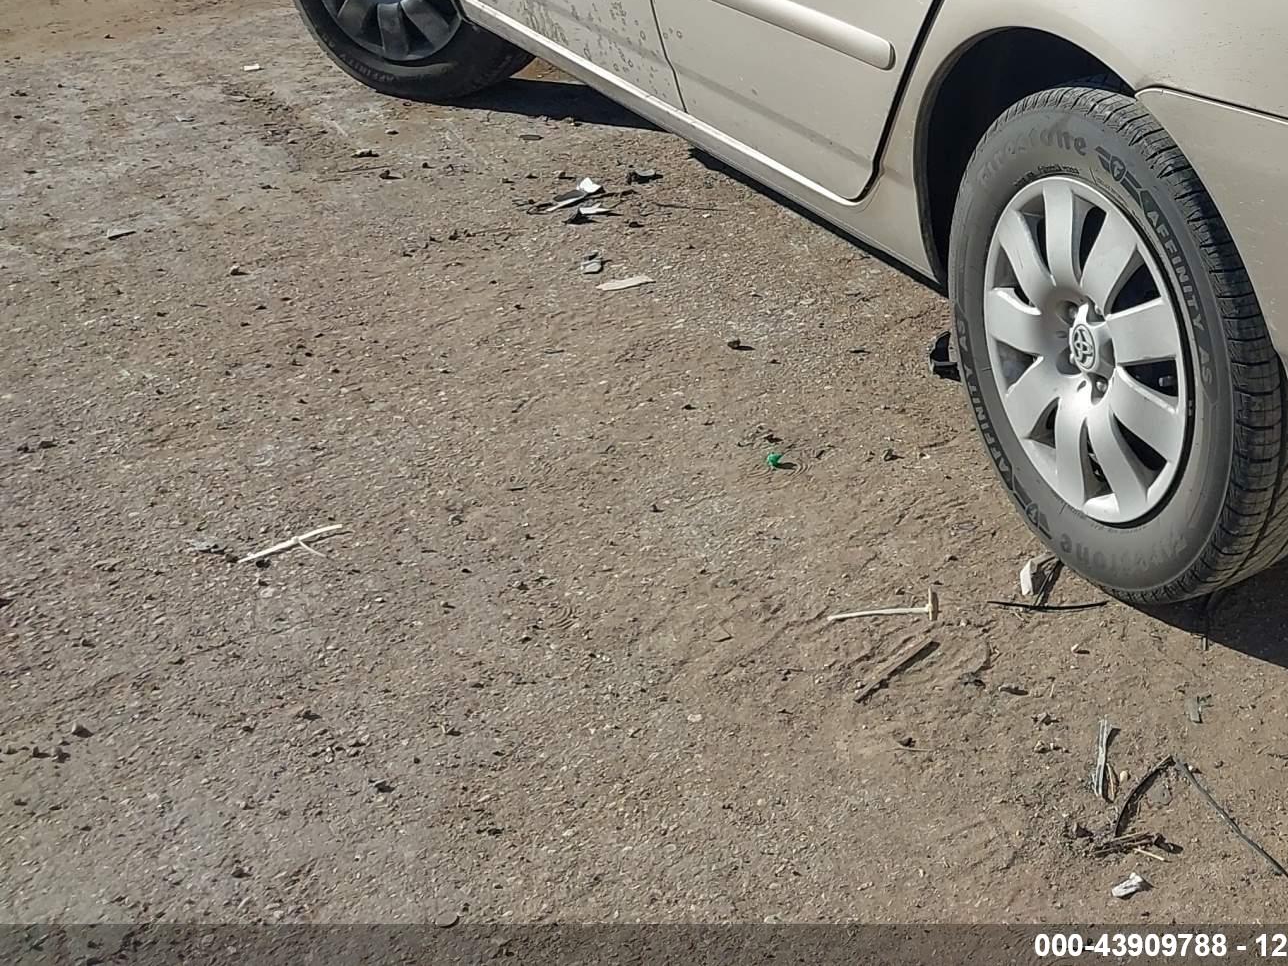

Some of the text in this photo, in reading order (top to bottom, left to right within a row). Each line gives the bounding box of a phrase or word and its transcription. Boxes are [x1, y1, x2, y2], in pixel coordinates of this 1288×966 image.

[1146, 210, 1213, 381] AFFINITY AS
[964, 363, 1009, 473] AFFINITY
